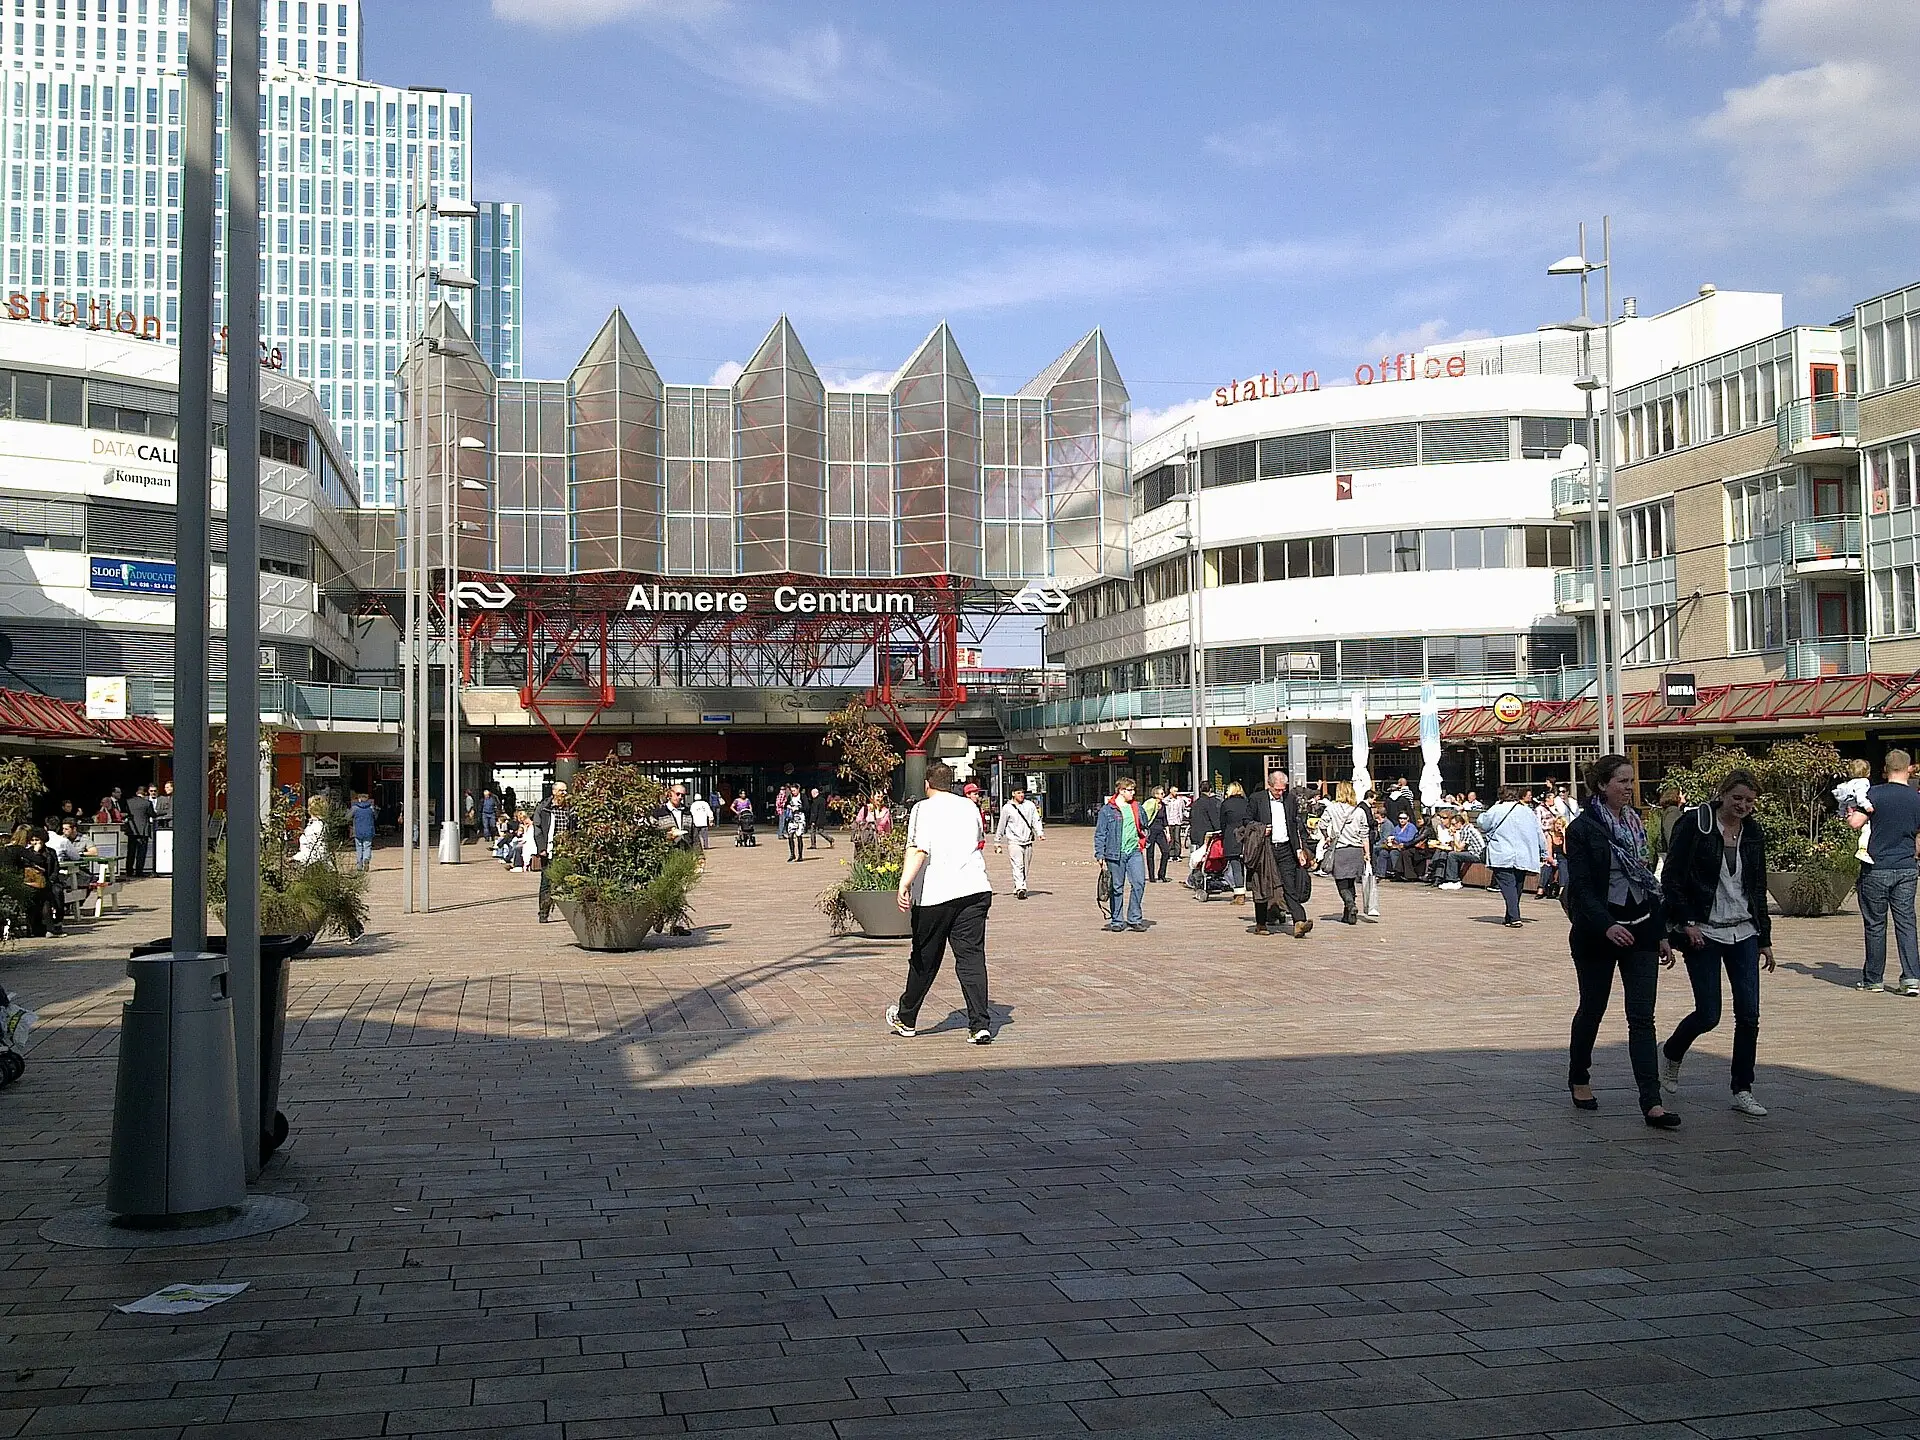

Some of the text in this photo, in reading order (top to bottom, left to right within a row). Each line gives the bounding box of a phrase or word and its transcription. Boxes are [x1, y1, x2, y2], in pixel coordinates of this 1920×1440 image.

[8, 291, 161, 340] station
[1215, 352, 1466, 407] station office
[116, 469, 171, 487] Kompaan
[92, 566, 121, 578] SLOOF
[625, 585, 914, 613] Almere Centrum
[1305, 656, 1316, 669] A
[1667, 685, 1695, 696] MITRA
[1245, 727, 1282, 737] Barakha
[1250, 736, 1277, 744] Markt
